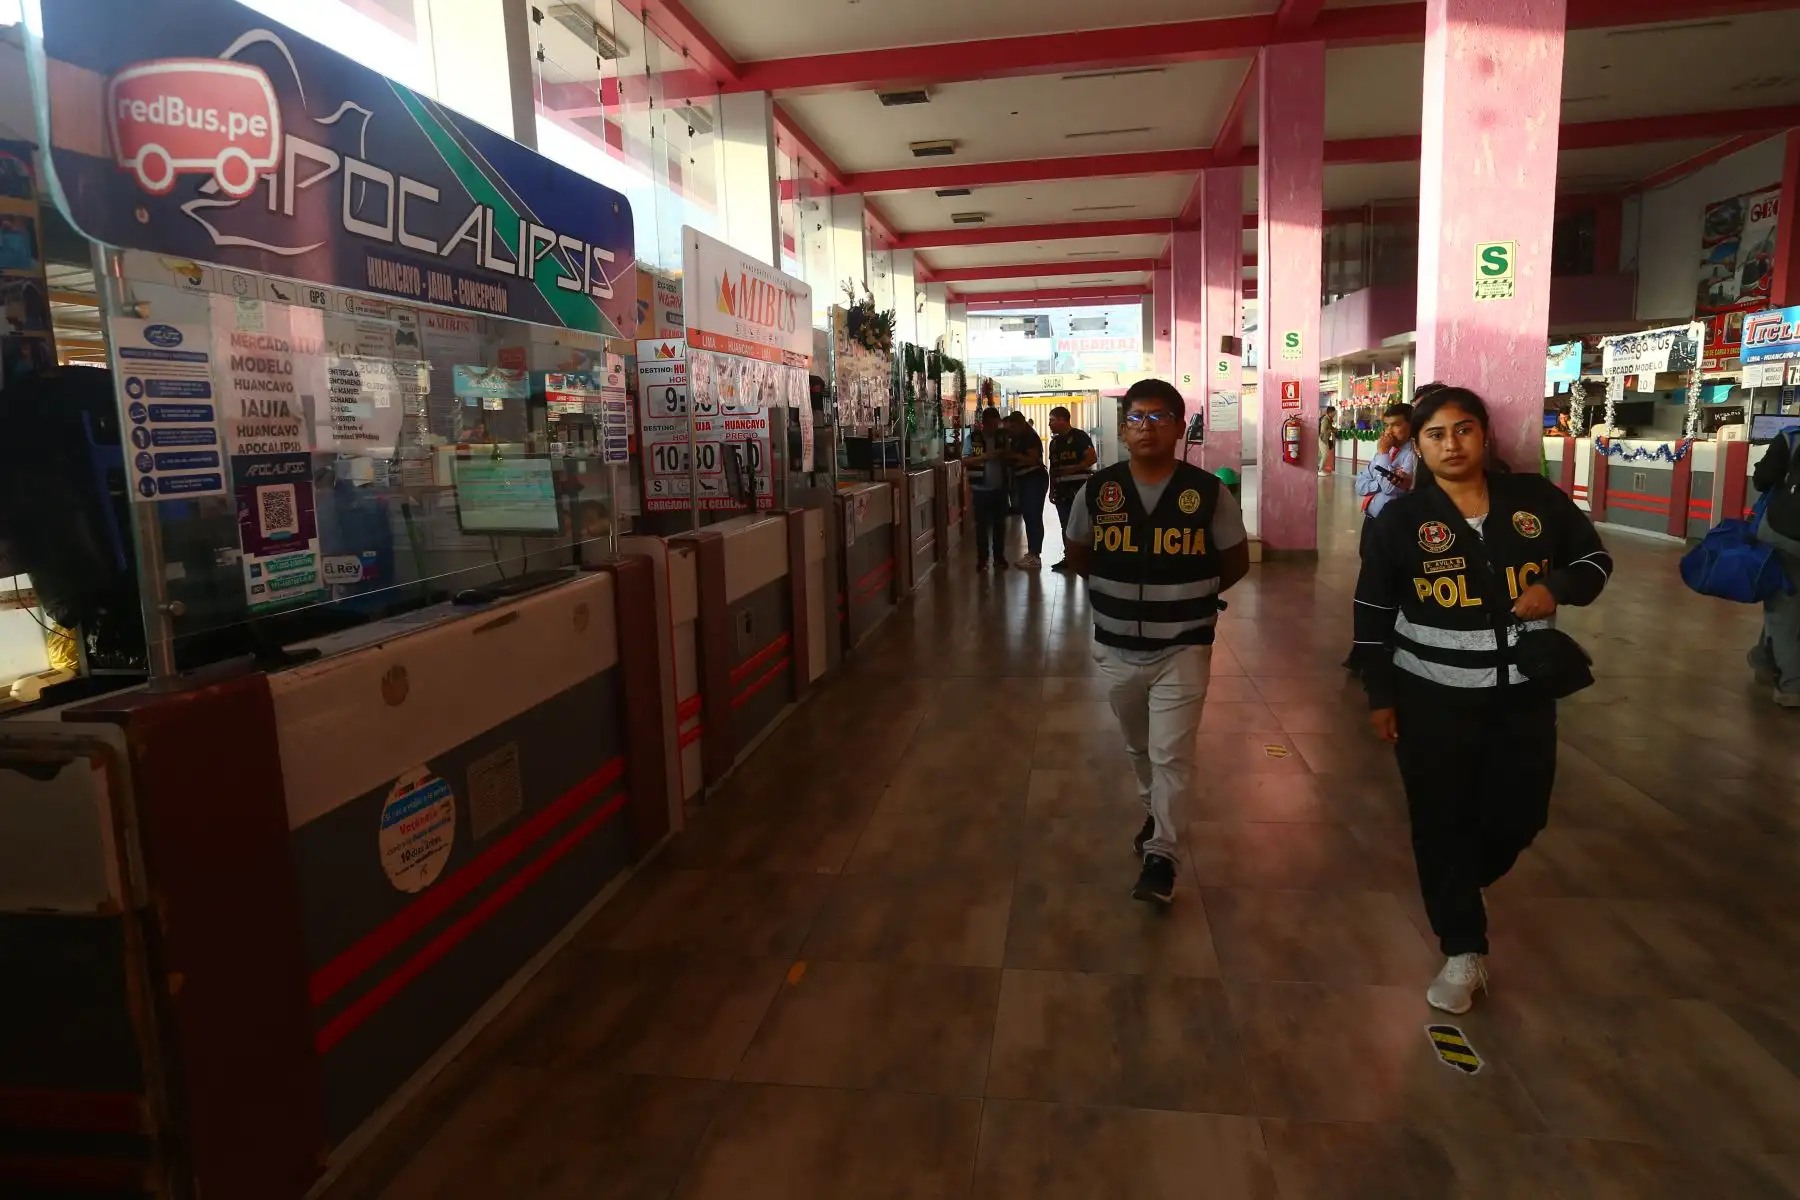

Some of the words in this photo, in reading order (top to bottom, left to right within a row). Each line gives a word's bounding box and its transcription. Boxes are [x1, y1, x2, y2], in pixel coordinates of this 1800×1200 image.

[118, 94, 268, 141] redBus.pe
[1480, 246, 1508, 276] S
[367, 256, 420, 296] HUANCAYO
[458, 278, 508, 314] CONCEPCIÓN
[310, 289, 326, 305] GPS
[737, 272, 797, 335] MIBUS
[702, 335, 716, 349] LIMA
[1285, 332, 1299, 348] S
[231, 355, 293, 375] MODELO
[1219, 361, 1228, 371] S
[234, 379, 294, 393] HUANCAYO
[237, 424, 299, 438] HUANCAYO
[238, 441, 301, 455] APOCALIPSIS
[653, 480, 662, 493] S
[1093, 525, 1138, 552] POL
[338, 564, 360, 575] Rey
[1413, 575, 1482, 608] POL
[1505, 558, 1549, 600] IC
